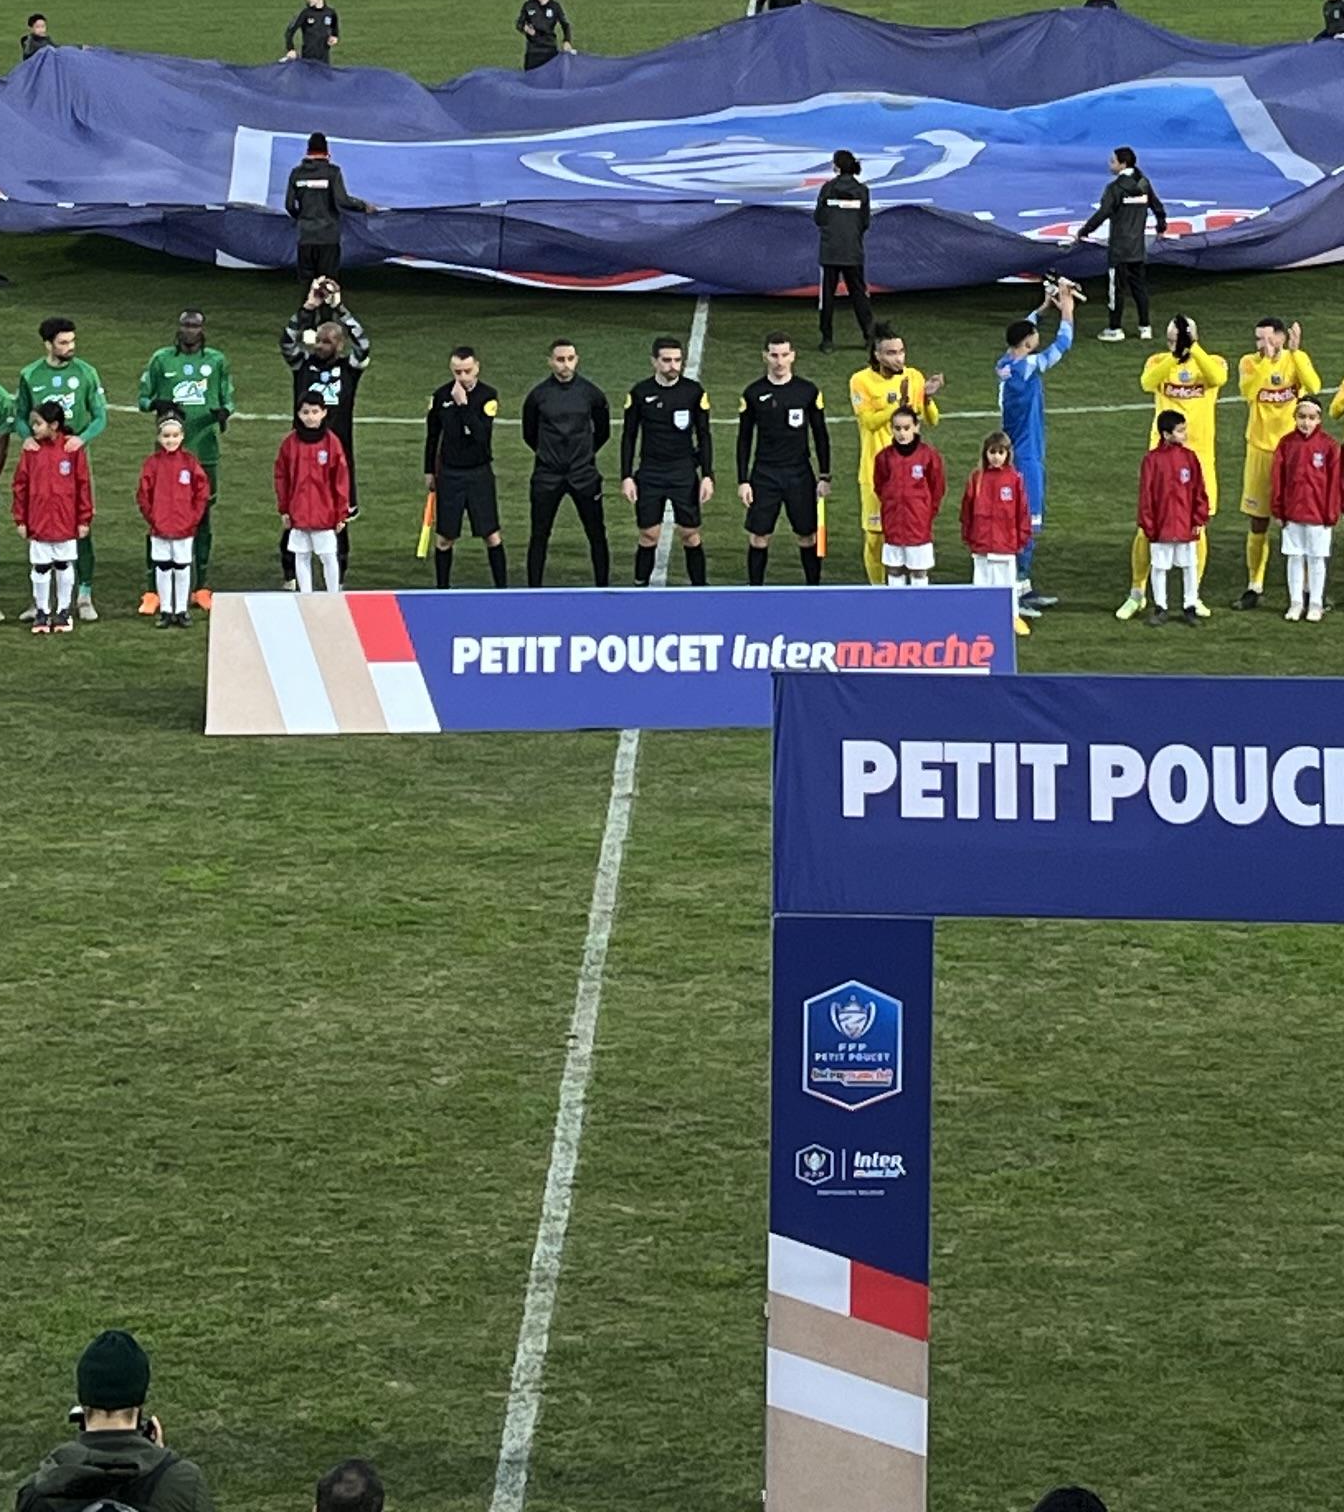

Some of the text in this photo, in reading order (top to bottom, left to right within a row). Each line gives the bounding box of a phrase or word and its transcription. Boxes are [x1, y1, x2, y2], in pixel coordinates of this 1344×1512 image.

[453, 632, 994, 675] PETIT POUCET Intermarché
[841, 740, 1067, 821] PETIT
[854, 1151, 906, 1176] Inter
